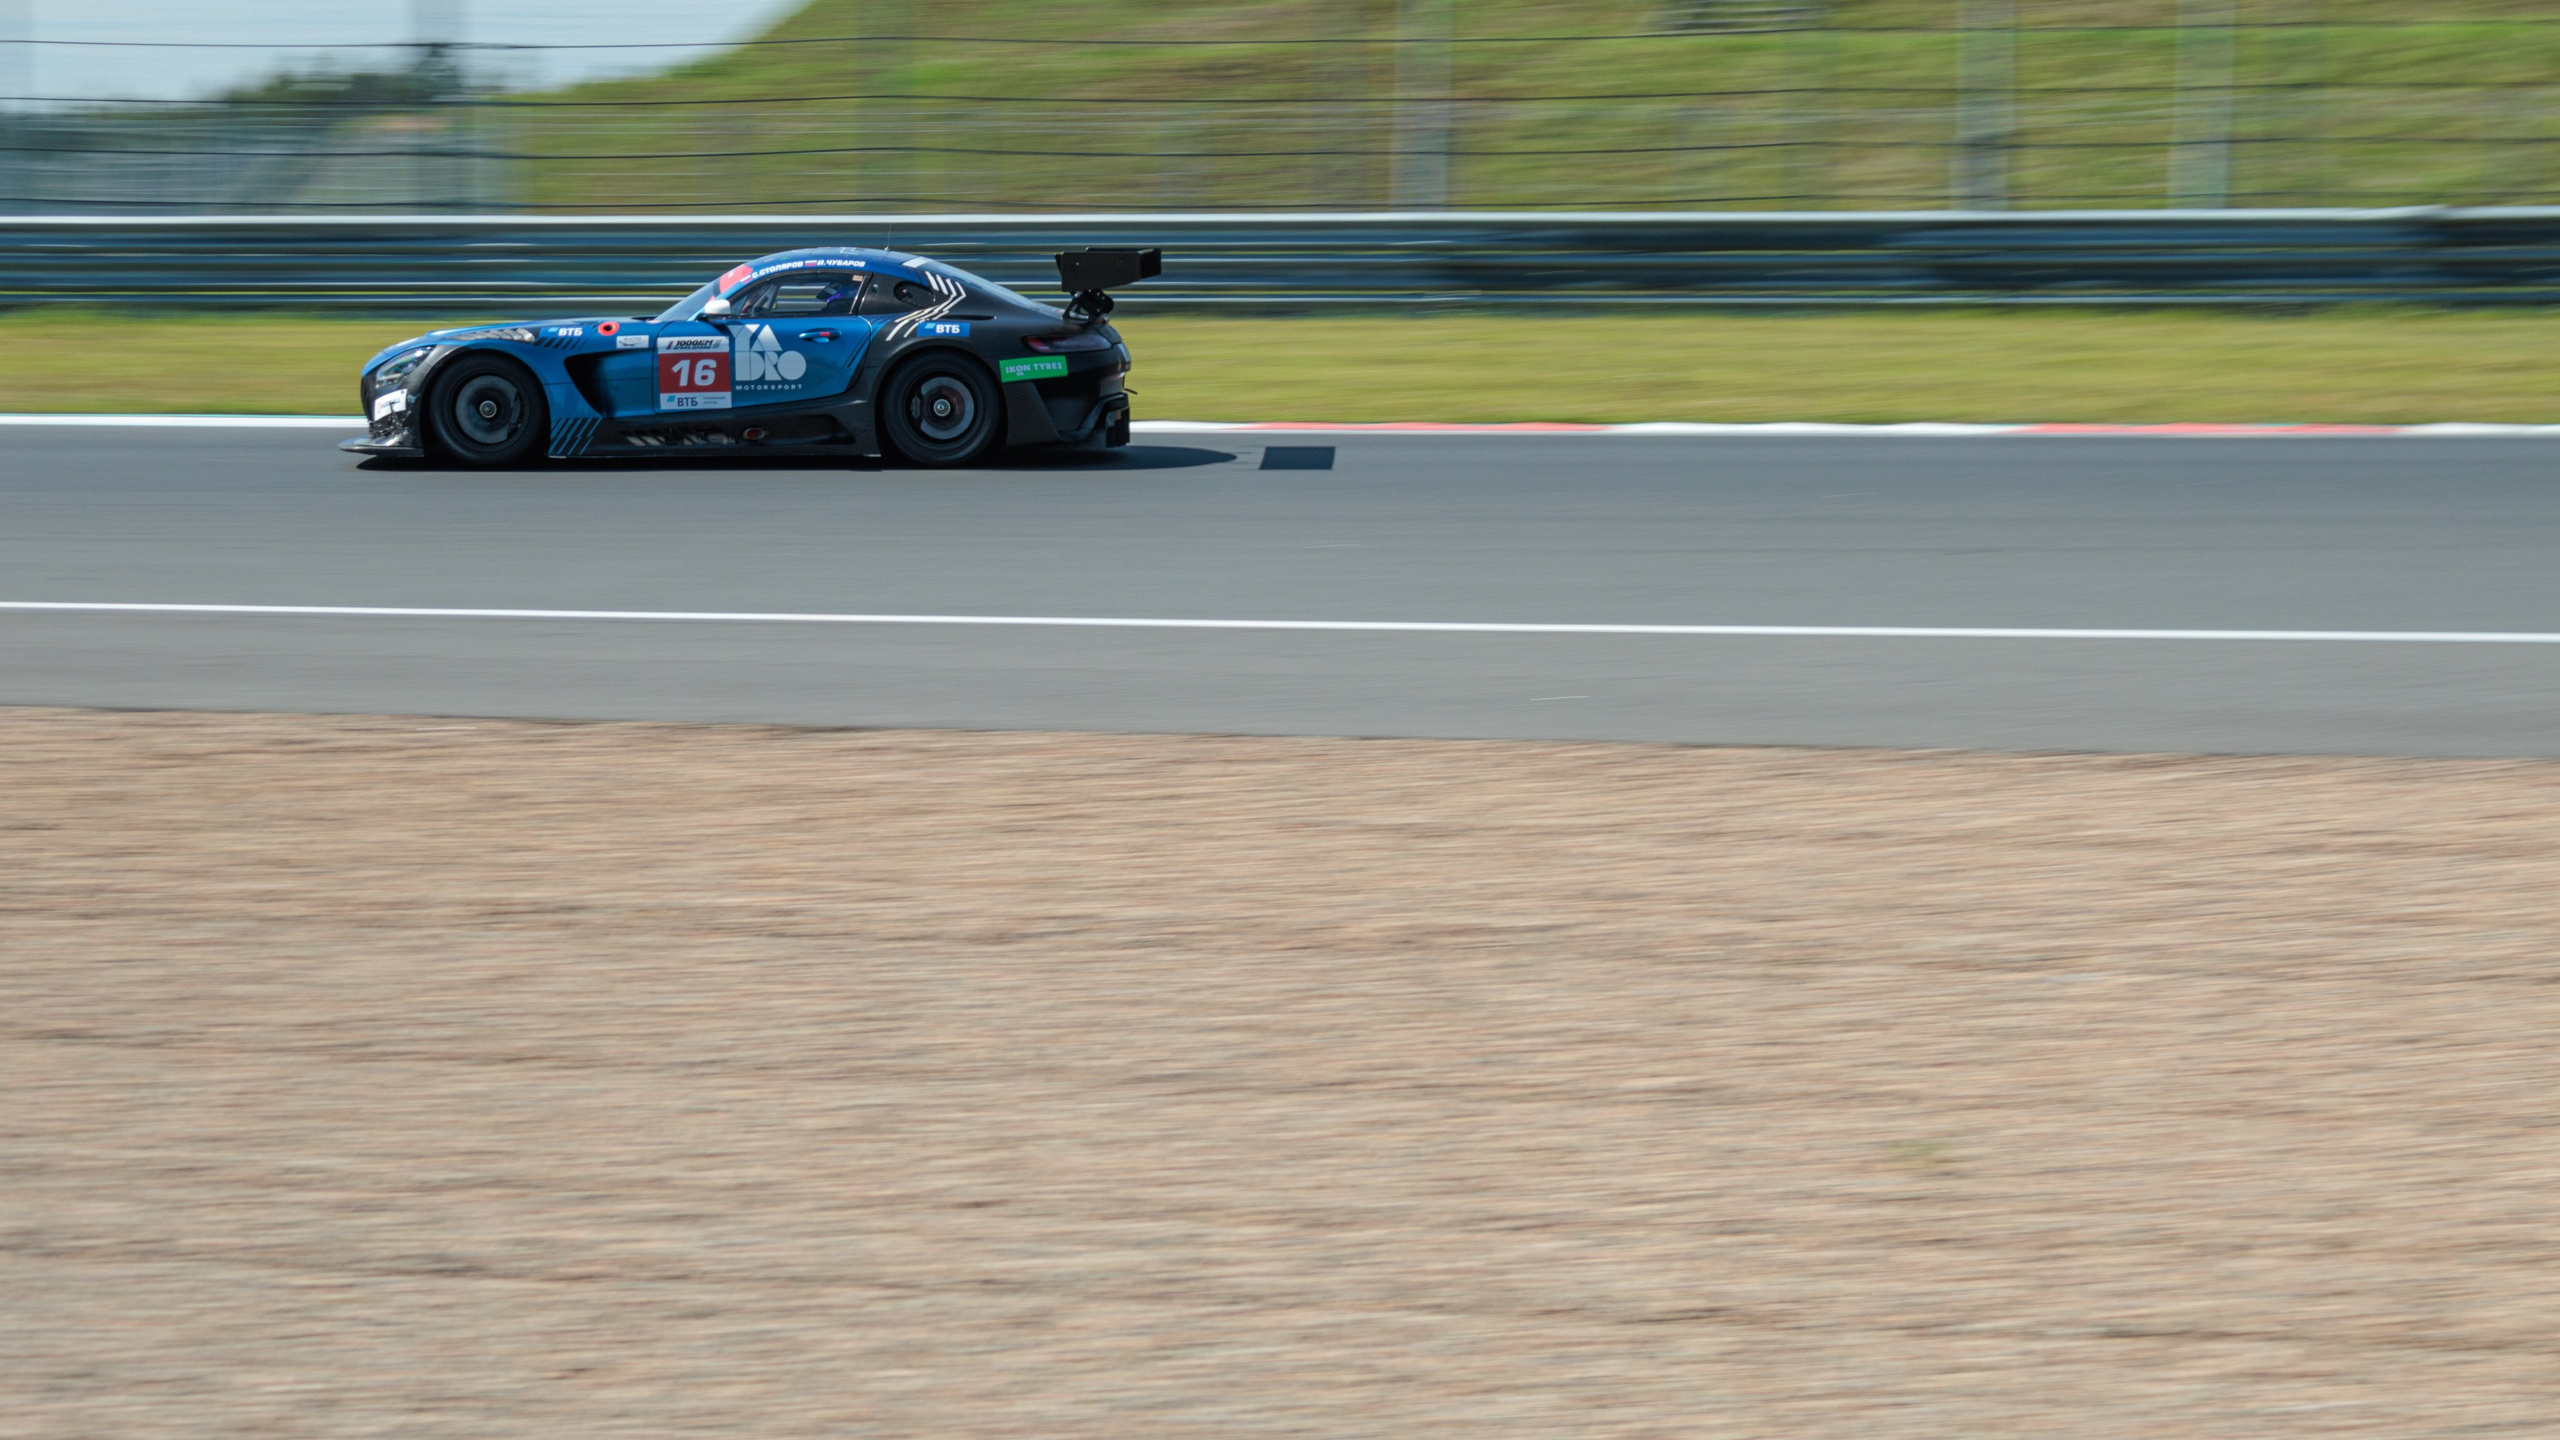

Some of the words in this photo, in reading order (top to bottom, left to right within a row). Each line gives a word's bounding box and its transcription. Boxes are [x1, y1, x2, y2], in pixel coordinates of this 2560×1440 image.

[817, 259, 866, 268] И.ЧУБАРОВ
[752, 260, 803, 279] С.СТОЛЯРОВ
[558, 327, 583, 337] ВТБ
[935, 324, 960, 334] ВТБ
[671, 358, 718, 387] 16
[1005, 364, 1031, 374] IKON
[1033, 361, 1063, 371] TYRES
[677, 396, 698, 407] ВТБ
